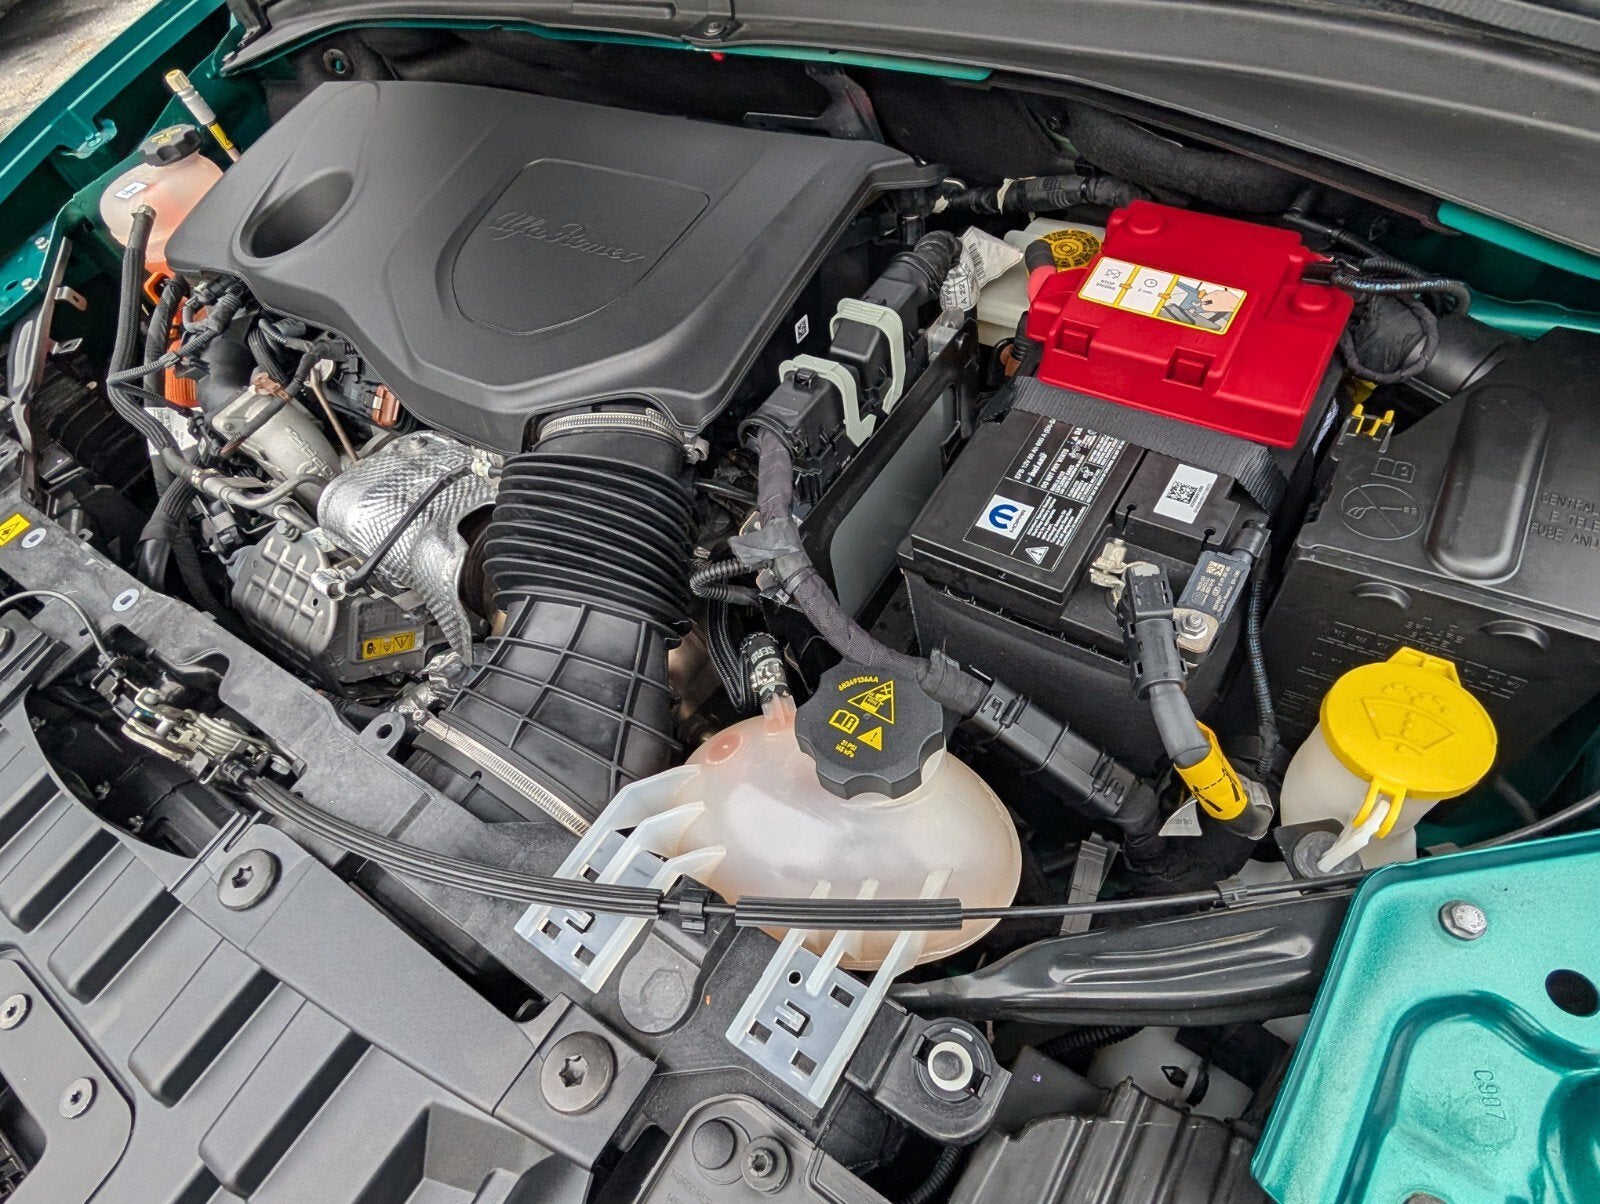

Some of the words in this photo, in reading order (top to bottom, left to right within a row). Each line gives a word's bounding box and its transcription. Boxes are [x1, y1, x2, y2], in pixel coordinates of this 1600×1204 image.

[489, 212, 548, 241] Alfa
[546, 223, 646, 262] Romeo
[1014, 468, 1024, 479] EFB
[1010, 509, 1026, 533] MOPAR
[1530, 521, 1563, 541] FUSE
[847, 742, 857, 750] PSI
[1473, 1070, 1507, 1120] C907
